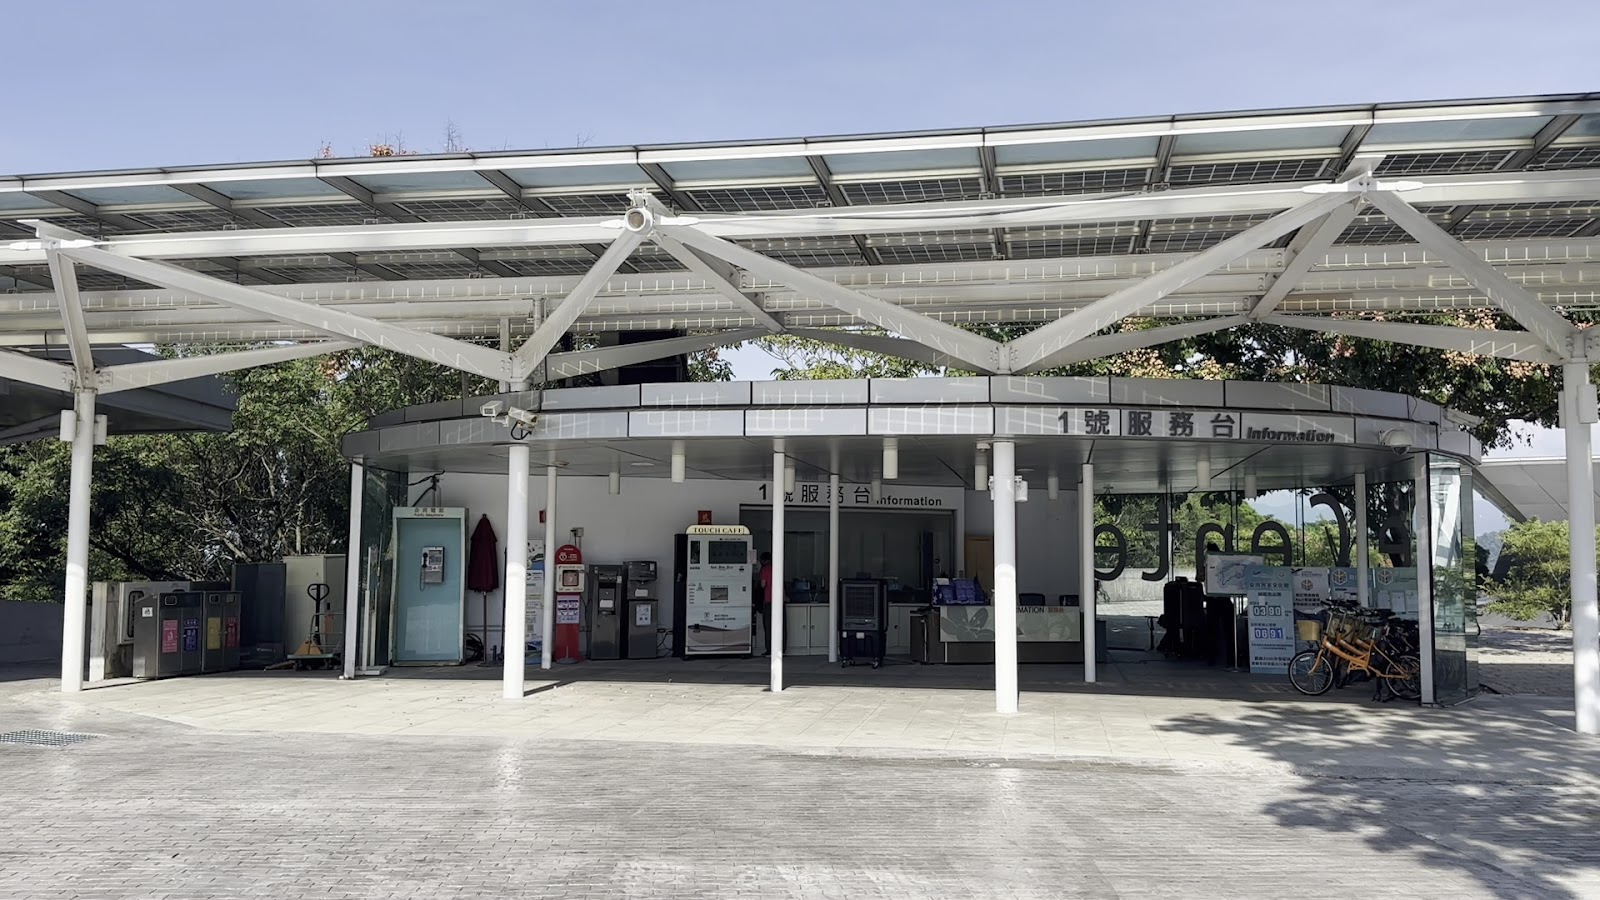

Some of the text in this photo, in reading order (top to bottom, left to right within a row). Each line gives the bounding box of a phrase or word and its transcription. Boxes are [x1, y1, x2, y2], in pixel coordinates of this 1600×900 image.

[1058, 409, 1335, 443] 1號服務台 Information
[758, 483, 871, 504] 1服台
[1254, 606, 1281, 616] 0390
[1255, 629, 1282, 638] 0691
